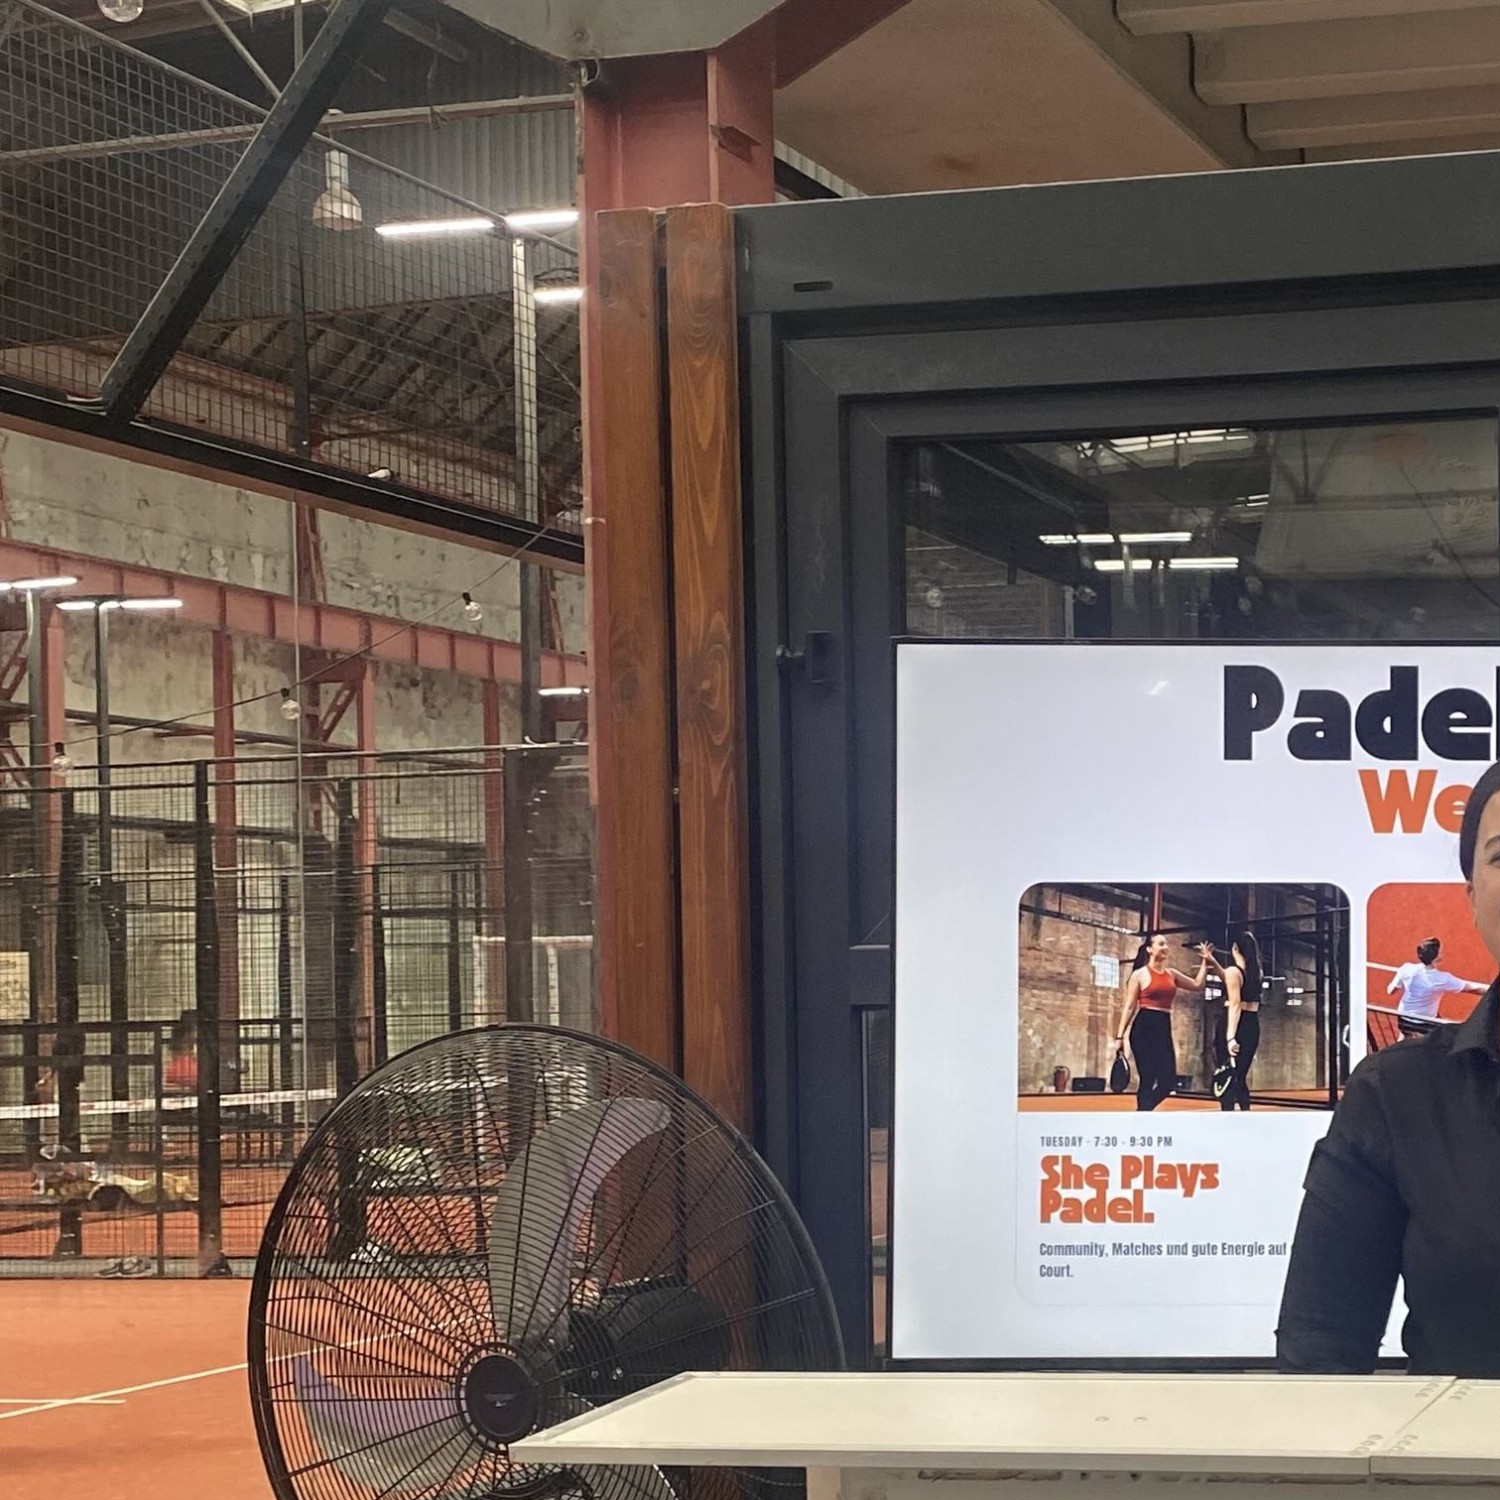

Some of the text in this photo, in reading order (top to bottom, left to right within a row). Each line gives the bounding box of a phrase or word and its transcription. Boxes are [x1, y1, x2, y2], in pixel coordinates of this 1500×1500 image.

[1040, 1135, 1083, 1147] TUESDAY
[1094, 1135, 1118, 1147] 7:30
[1129, 1135, 1154, 1147] 9:30
[1156, 1135, 1173, 1147] PM
[1040, 1154, 1220, 1198] She Plays
[1039, 1186, 1155, 1224] Padel.
[1039, 1241, 1287, 1258] Community, Matches und gute Energie auf
[1039, 1264, 1075, 1278] Court.
